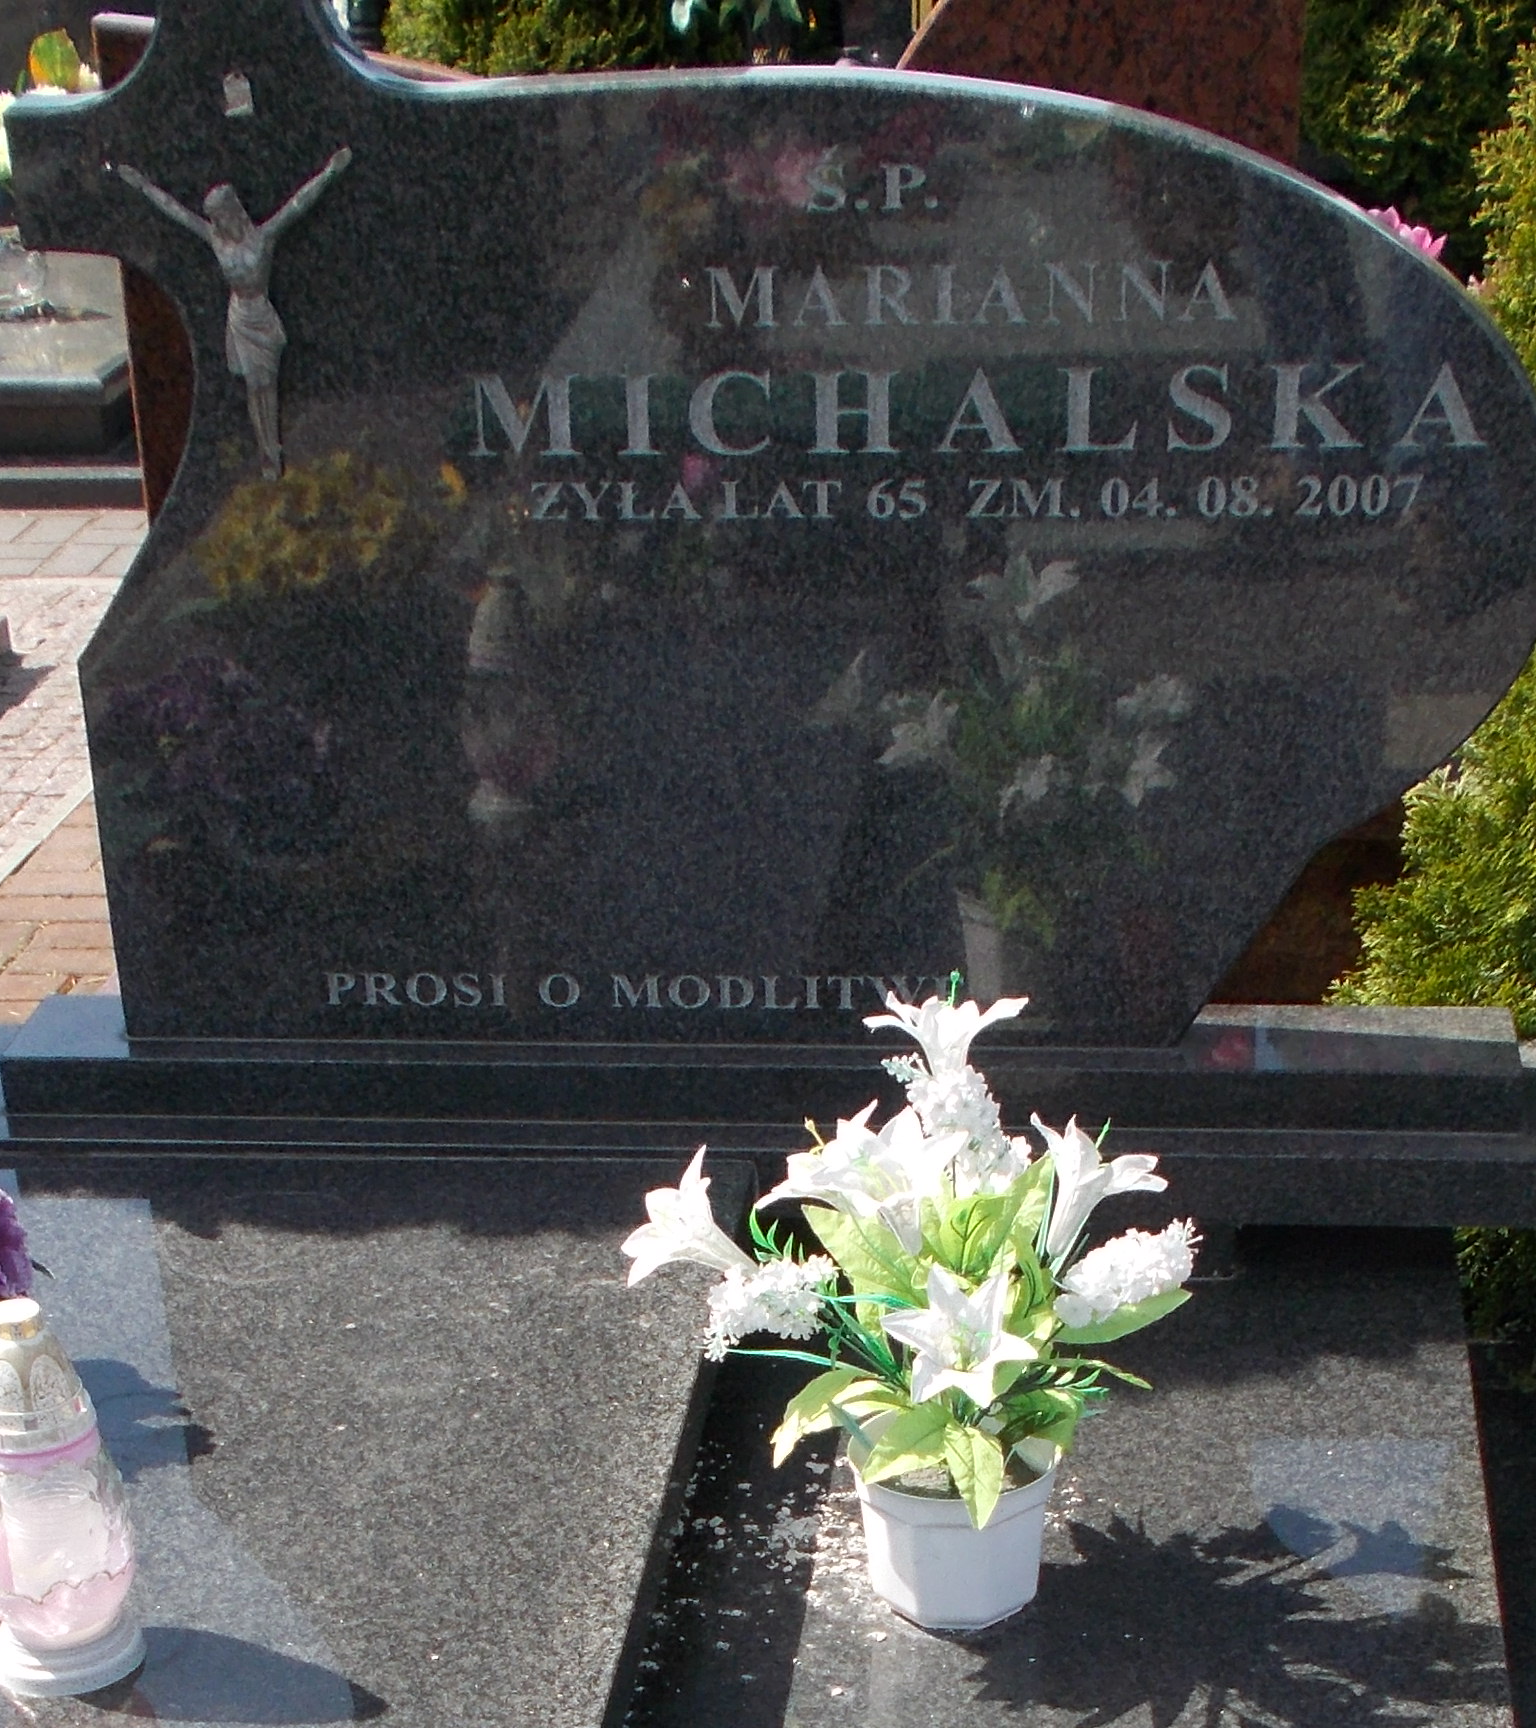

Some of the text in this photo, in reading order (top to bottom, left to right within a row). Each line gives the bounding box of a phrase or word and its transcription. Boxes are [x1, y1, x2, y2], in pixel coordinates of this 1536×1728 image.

[704, 257, 1239, 328] MARIANNA
[467, 361, 1488, 457] MICHALSKA
[719, 479, 842, 520] LAT
[866, 477, 928, 520] 65
[965, 476, 1081, 518] ZM.
[1100, 475, 1177, 518] 04.
[1196, 474, 1274, 518] 08.
[1295, 473, 1425, 517] 2007
[323, 971, 509, 1008] PROSI
[538, 972, 581, 1009] O
